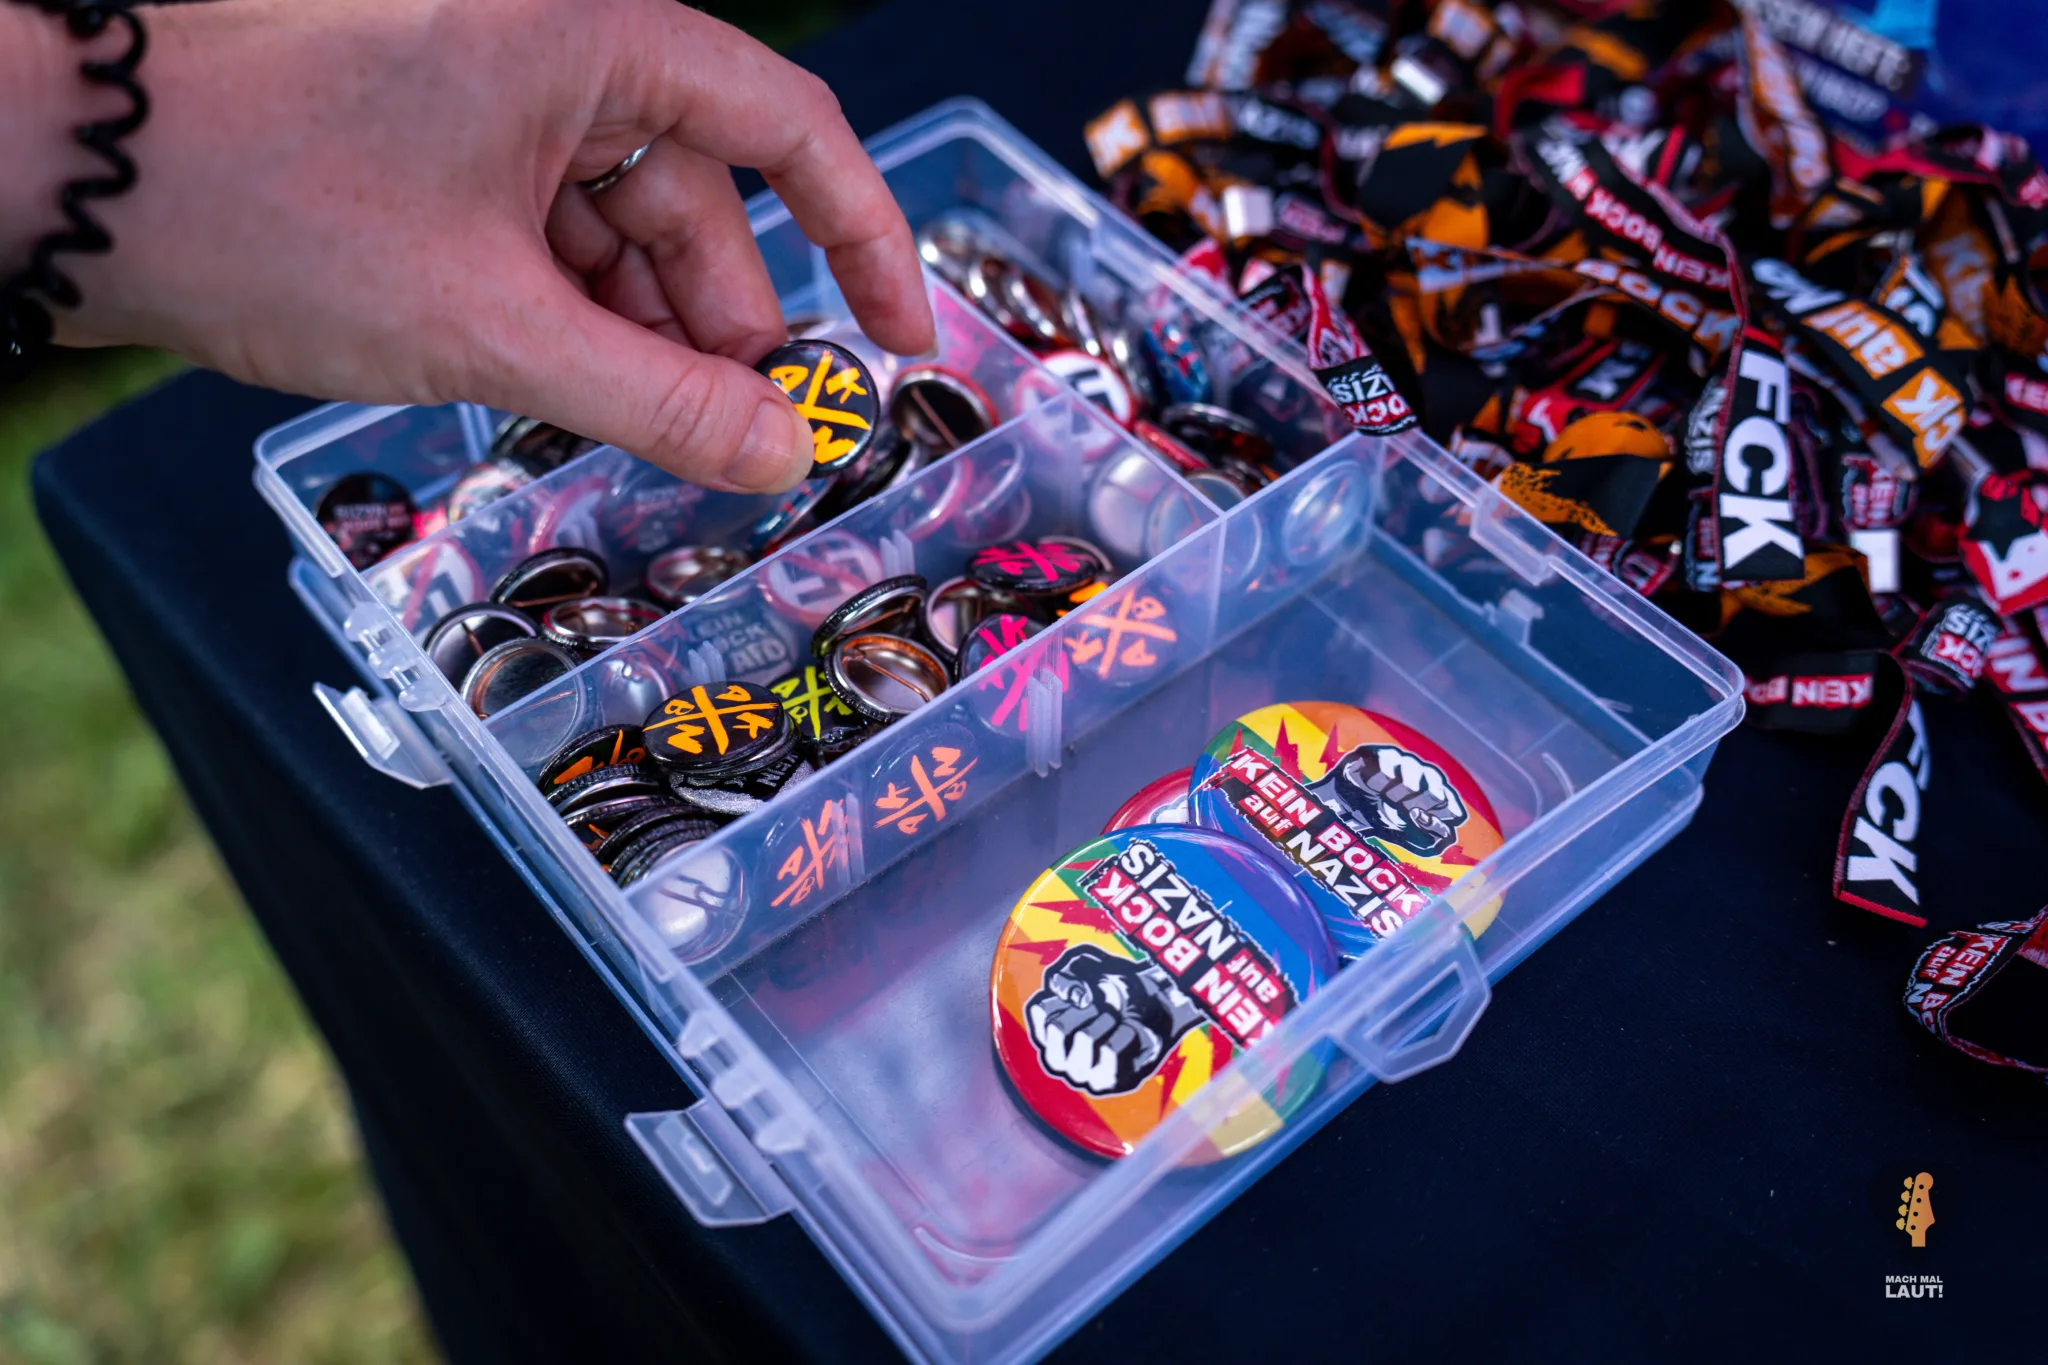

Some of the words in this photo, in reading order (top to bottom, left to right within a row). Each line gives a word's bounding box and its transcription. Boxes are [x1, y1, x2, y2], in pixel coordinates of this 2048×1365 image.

[1585, 187, 1662, 249] BOCK
[1653, 244, 1730, 288] KEIN
[1575, 259, 1740, 350] BOCK
[1332, 373, 1396, 403] ZIS
[1345, 394, 1407, 424] OCK
[1892, 374, 1960, 450] CK
[1720, 350, 1804, 569] FCK
[1792, 677, 1873, 705] KEIN
[1232, 754, 1318, 826] KEIN
[1317, 824, 1424, 916] BOCK
[1847, 700, 1932, 905] FCK
[1244, 795, 1293, 832] auf
[1286, 830, 1403, 939] NAZIS
[1095, 871, 1202, 972] BOCK
[1120, 844, 1236, 961] NAZIS
[1226, 955, 1279, 1003] auf
[1925, 946, 1957, 979] auf
[1938, 936, 2001, 987] KEIN
